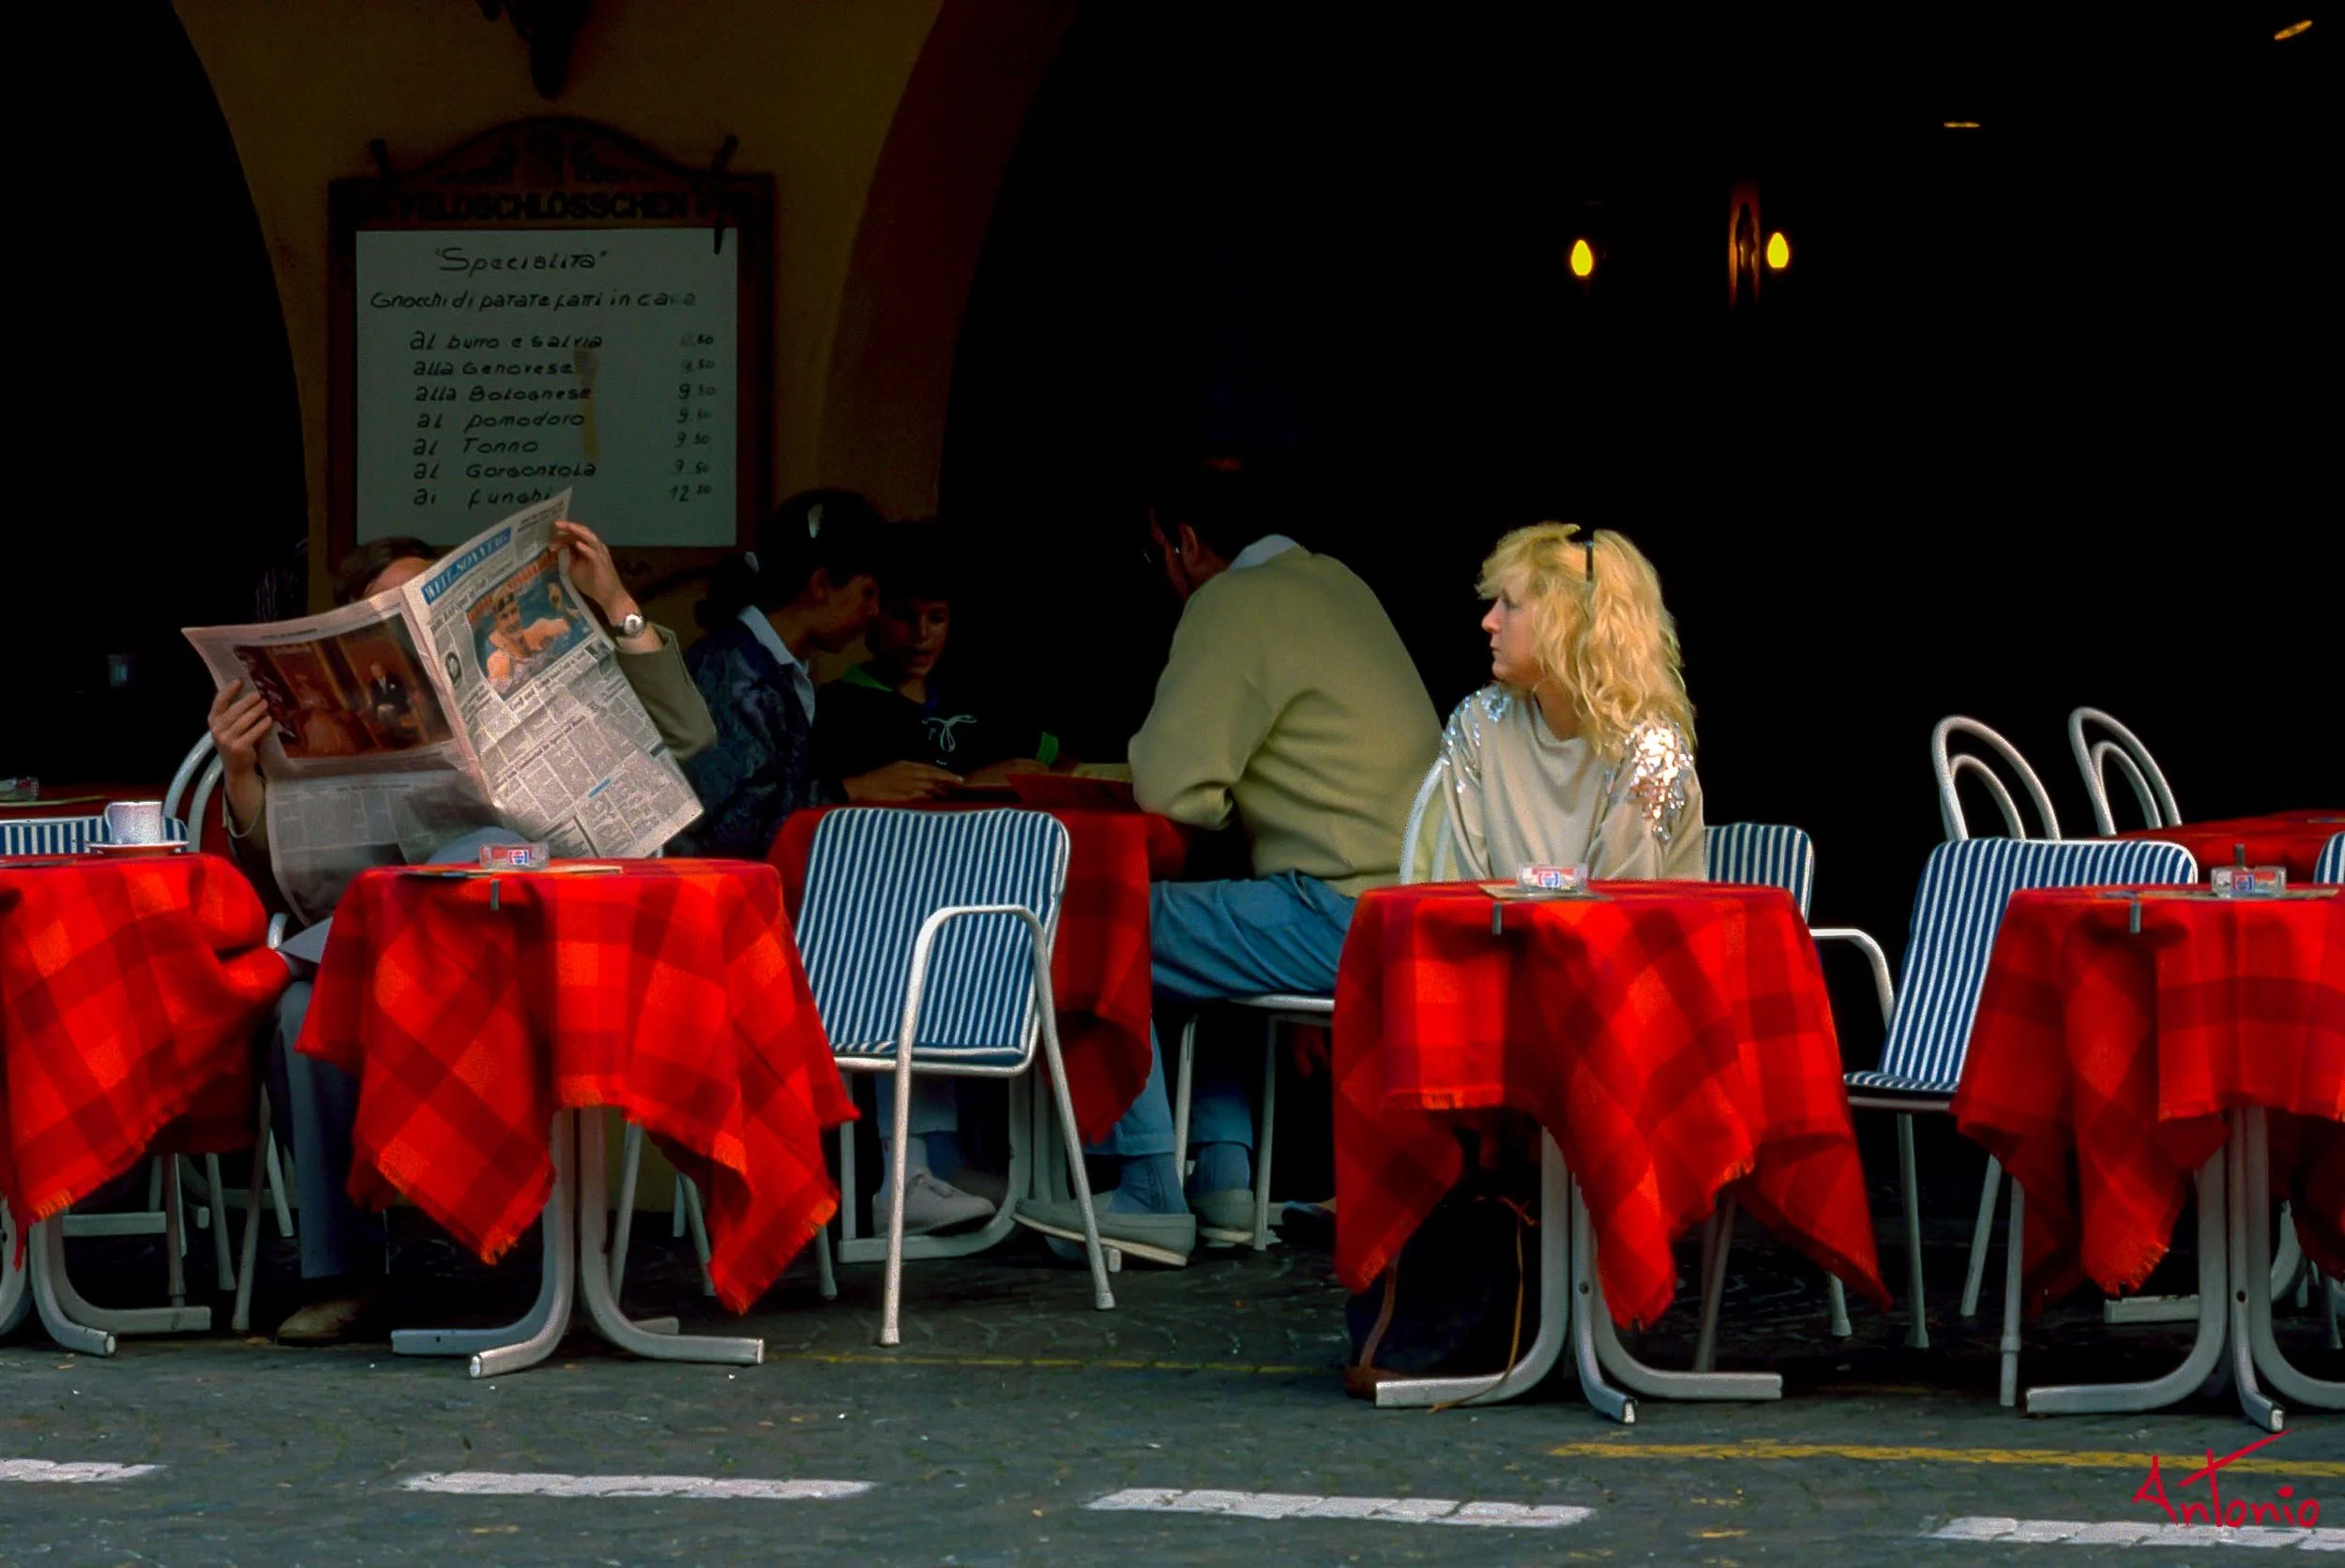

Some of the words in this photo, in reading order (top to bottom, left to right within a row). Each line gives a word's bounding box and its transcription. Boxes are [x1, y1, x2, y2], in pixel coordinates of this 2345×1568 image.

[452, 290, 473, 309] di
[610, 289, 630, 307] in
[447, 334, 499, 349] burro
[413, 360, 453, 376] alla
[462, 362, 574, 375] Genovese
[416, 385, 457, 401] alla
[463, 410, 585, 432] pomodoro
[463, 437, 538, 454] Tonno
[414, 488, 435, 505] ai
